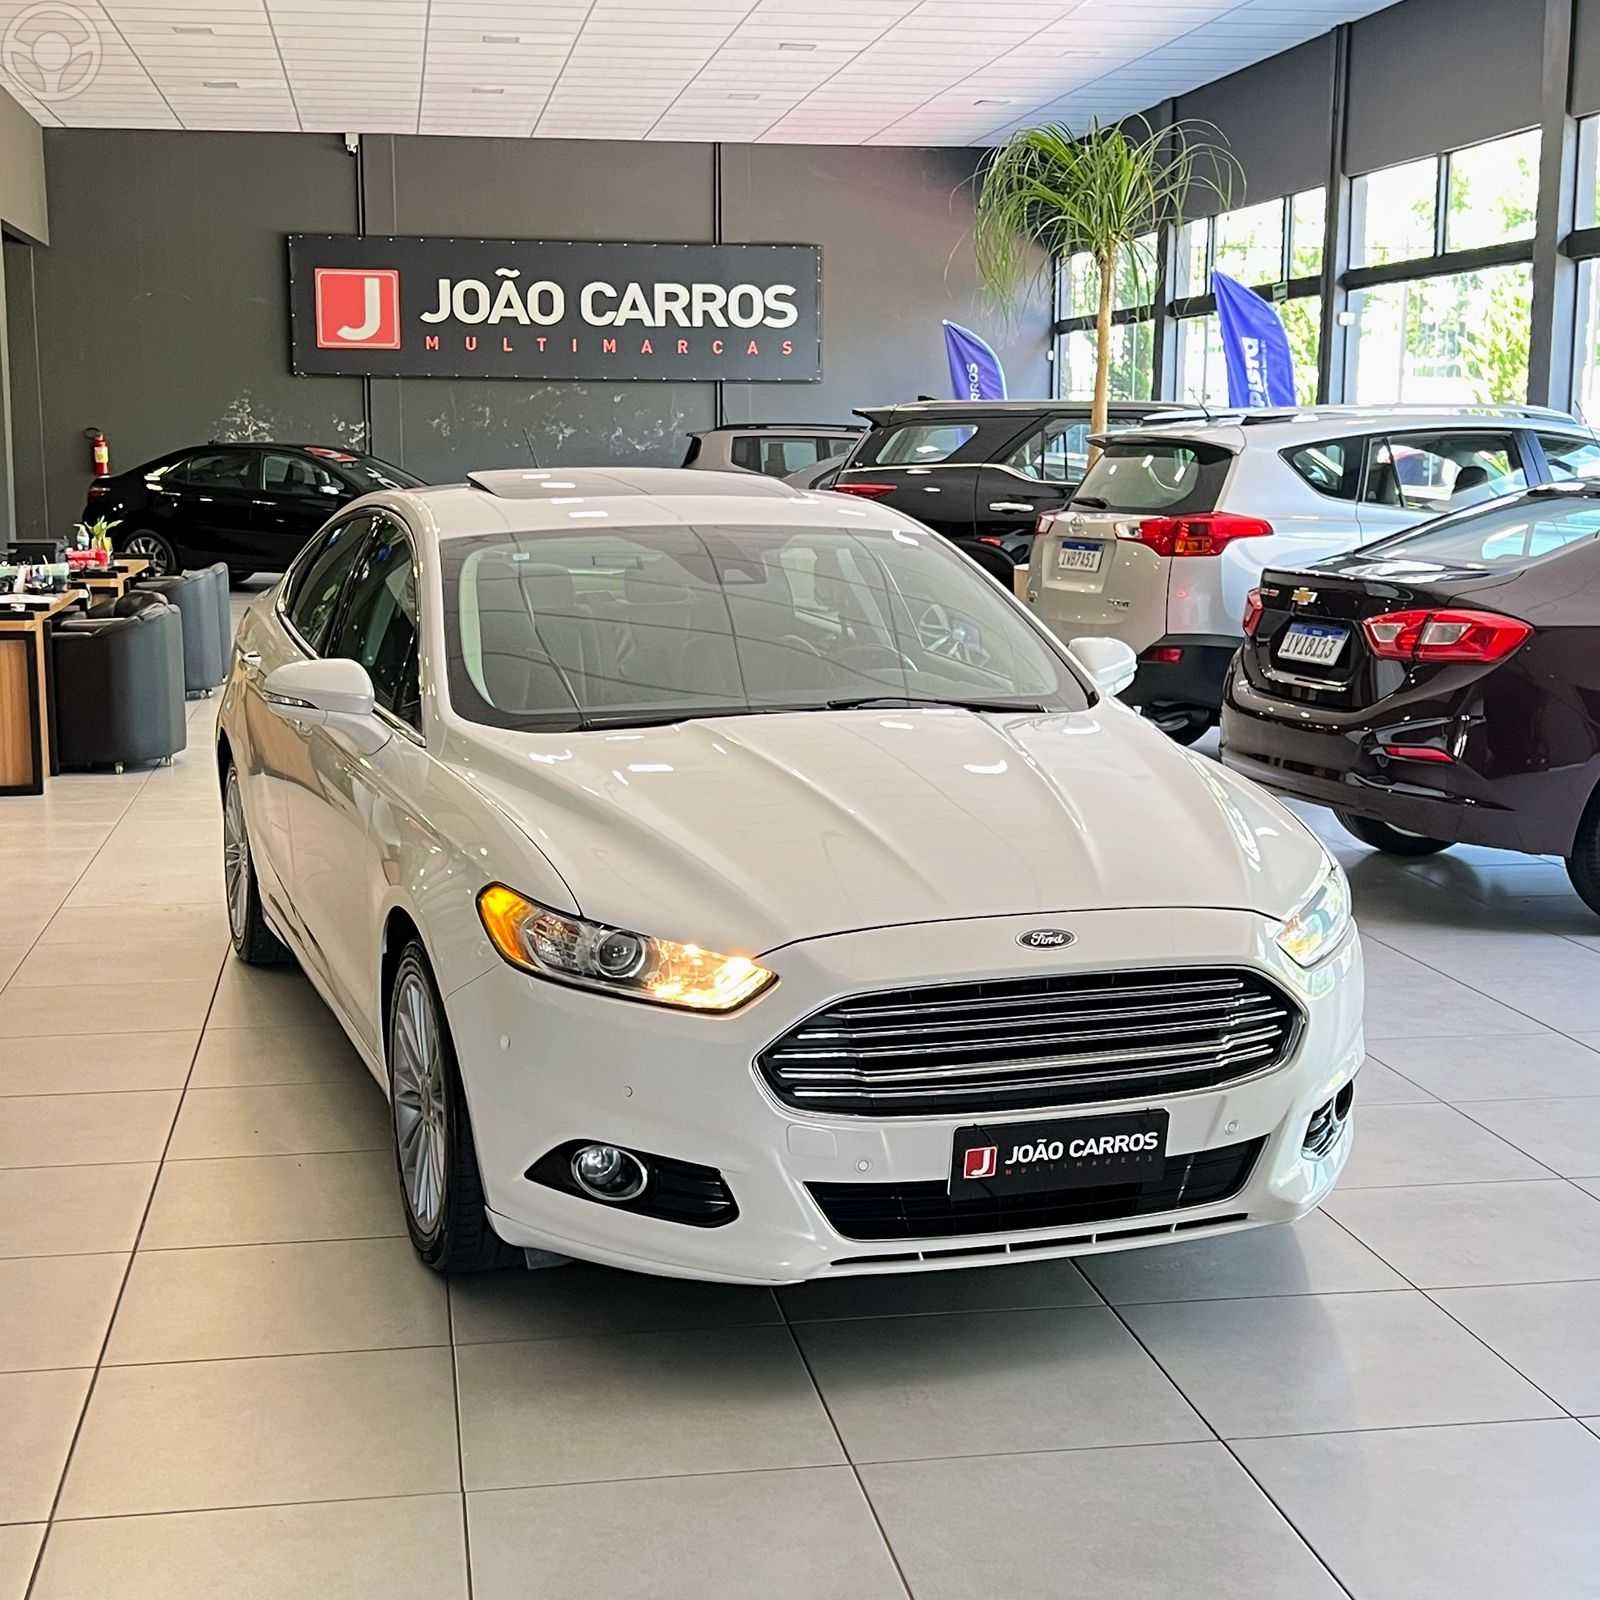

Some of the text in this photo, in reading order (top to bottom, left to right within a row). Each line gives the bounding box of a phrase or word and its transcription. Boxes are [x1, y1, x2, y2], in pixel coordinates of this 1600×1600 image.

[336, 277, 381, 341] J
[420, 267, 799, 329] JOÃO CARROS
[425, 336, 793, 355] MULTIMARCAS
[966, 363, 982, 401] RROS
[1241, 336, 1266, 407] pista
[1031, 931, 1065, 946] Ford
[970, 1149, 991, 1176] J
[1005, 1131, 1159, 1165] JOÃO CARROS
